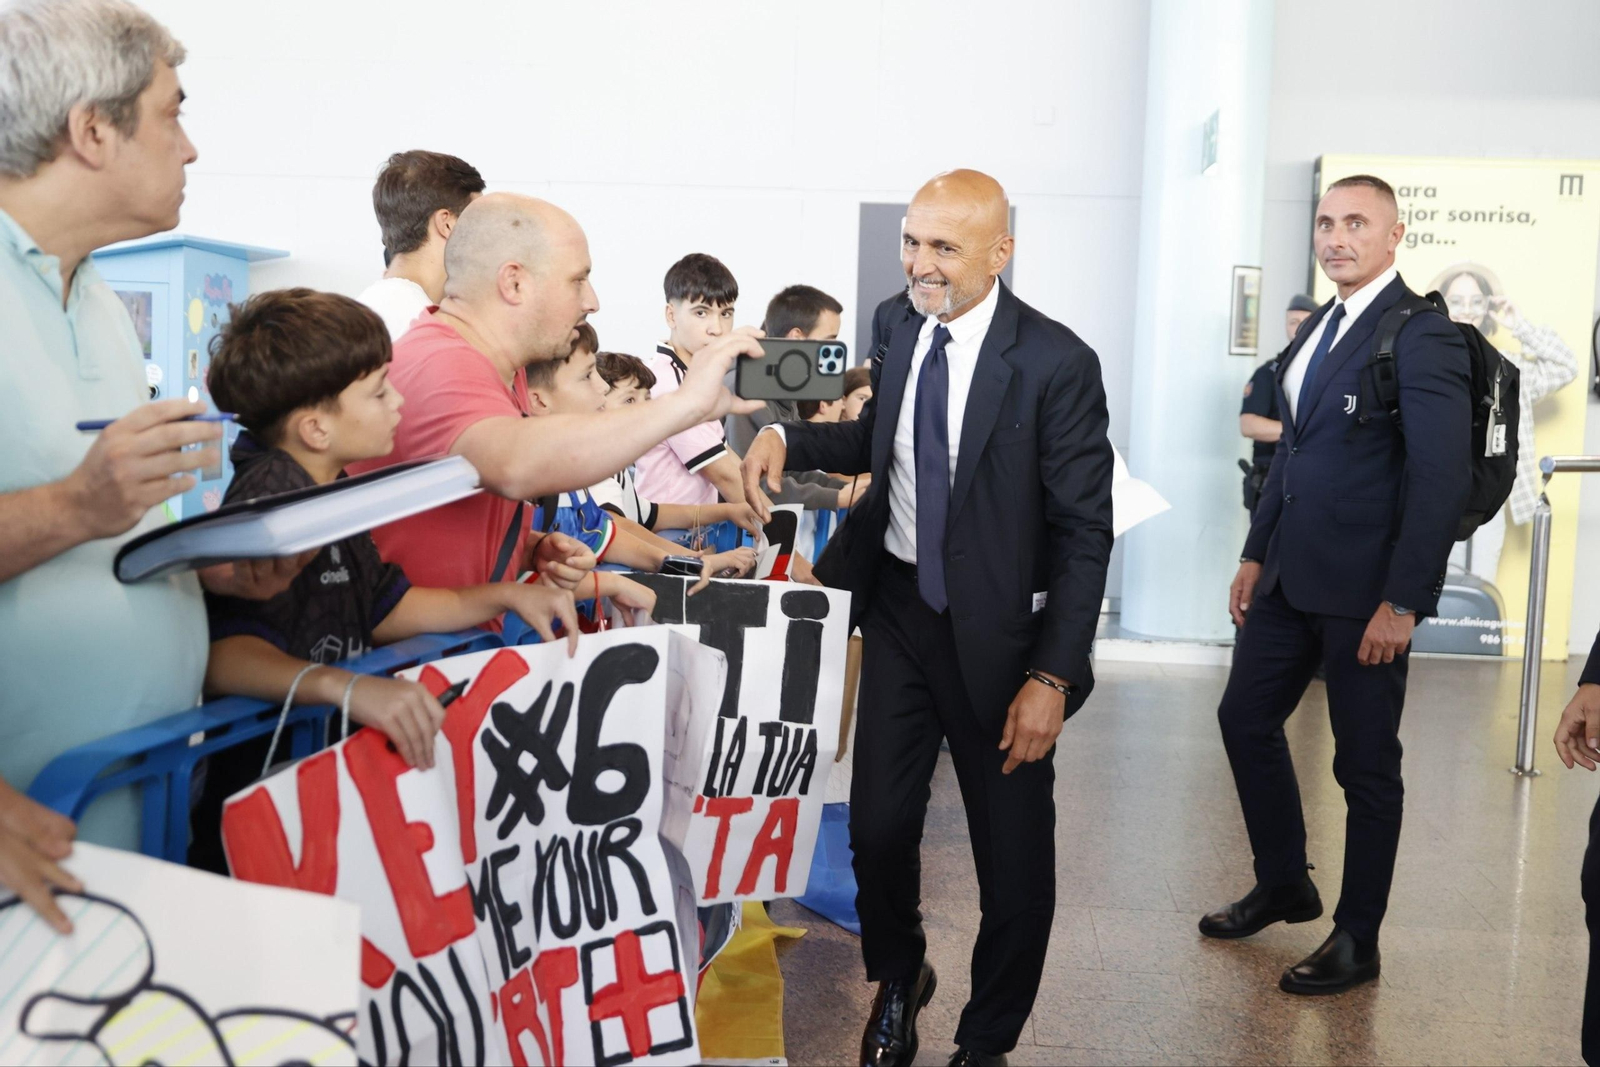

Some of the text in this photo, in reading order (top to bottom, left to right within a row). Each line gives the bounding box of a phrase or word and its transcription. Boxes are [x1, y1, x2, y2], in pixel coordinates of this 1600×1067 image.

[1394, 186, 1437, 198] ara
[1398, 203, 1537, 226] ejor sonrisa,
[1405, 232, 1456, 249] ga...
[480, 642, 659, 840] #6
[703, 716, 817, 797] LA TUA
[532, 817, 658, 944] YOUR
